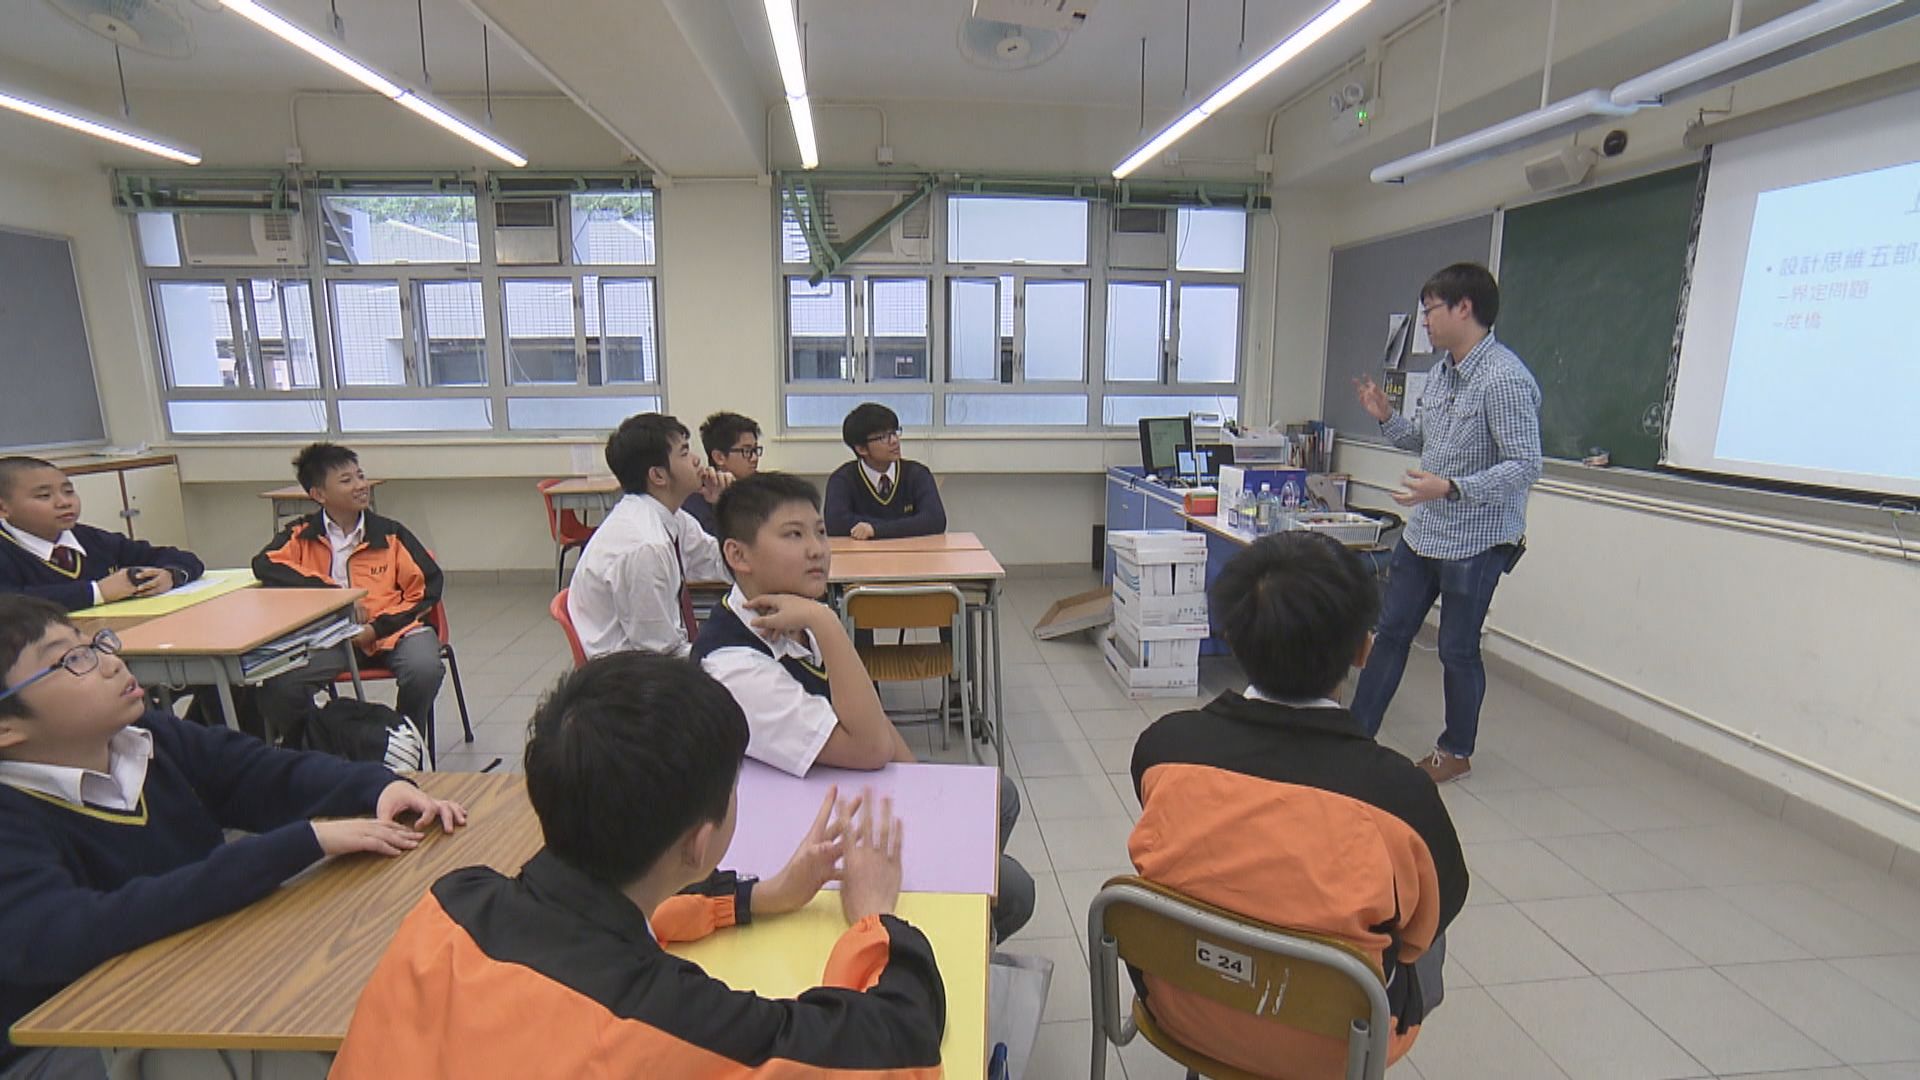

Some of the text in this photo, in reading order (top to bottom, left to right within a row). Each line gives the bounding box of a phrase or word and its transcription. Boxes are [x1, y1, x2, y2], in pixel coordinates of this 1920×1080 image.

[1779, 242, 1920, 276] 設計思維五部
[1198, 948, 1243, 974] C 24
